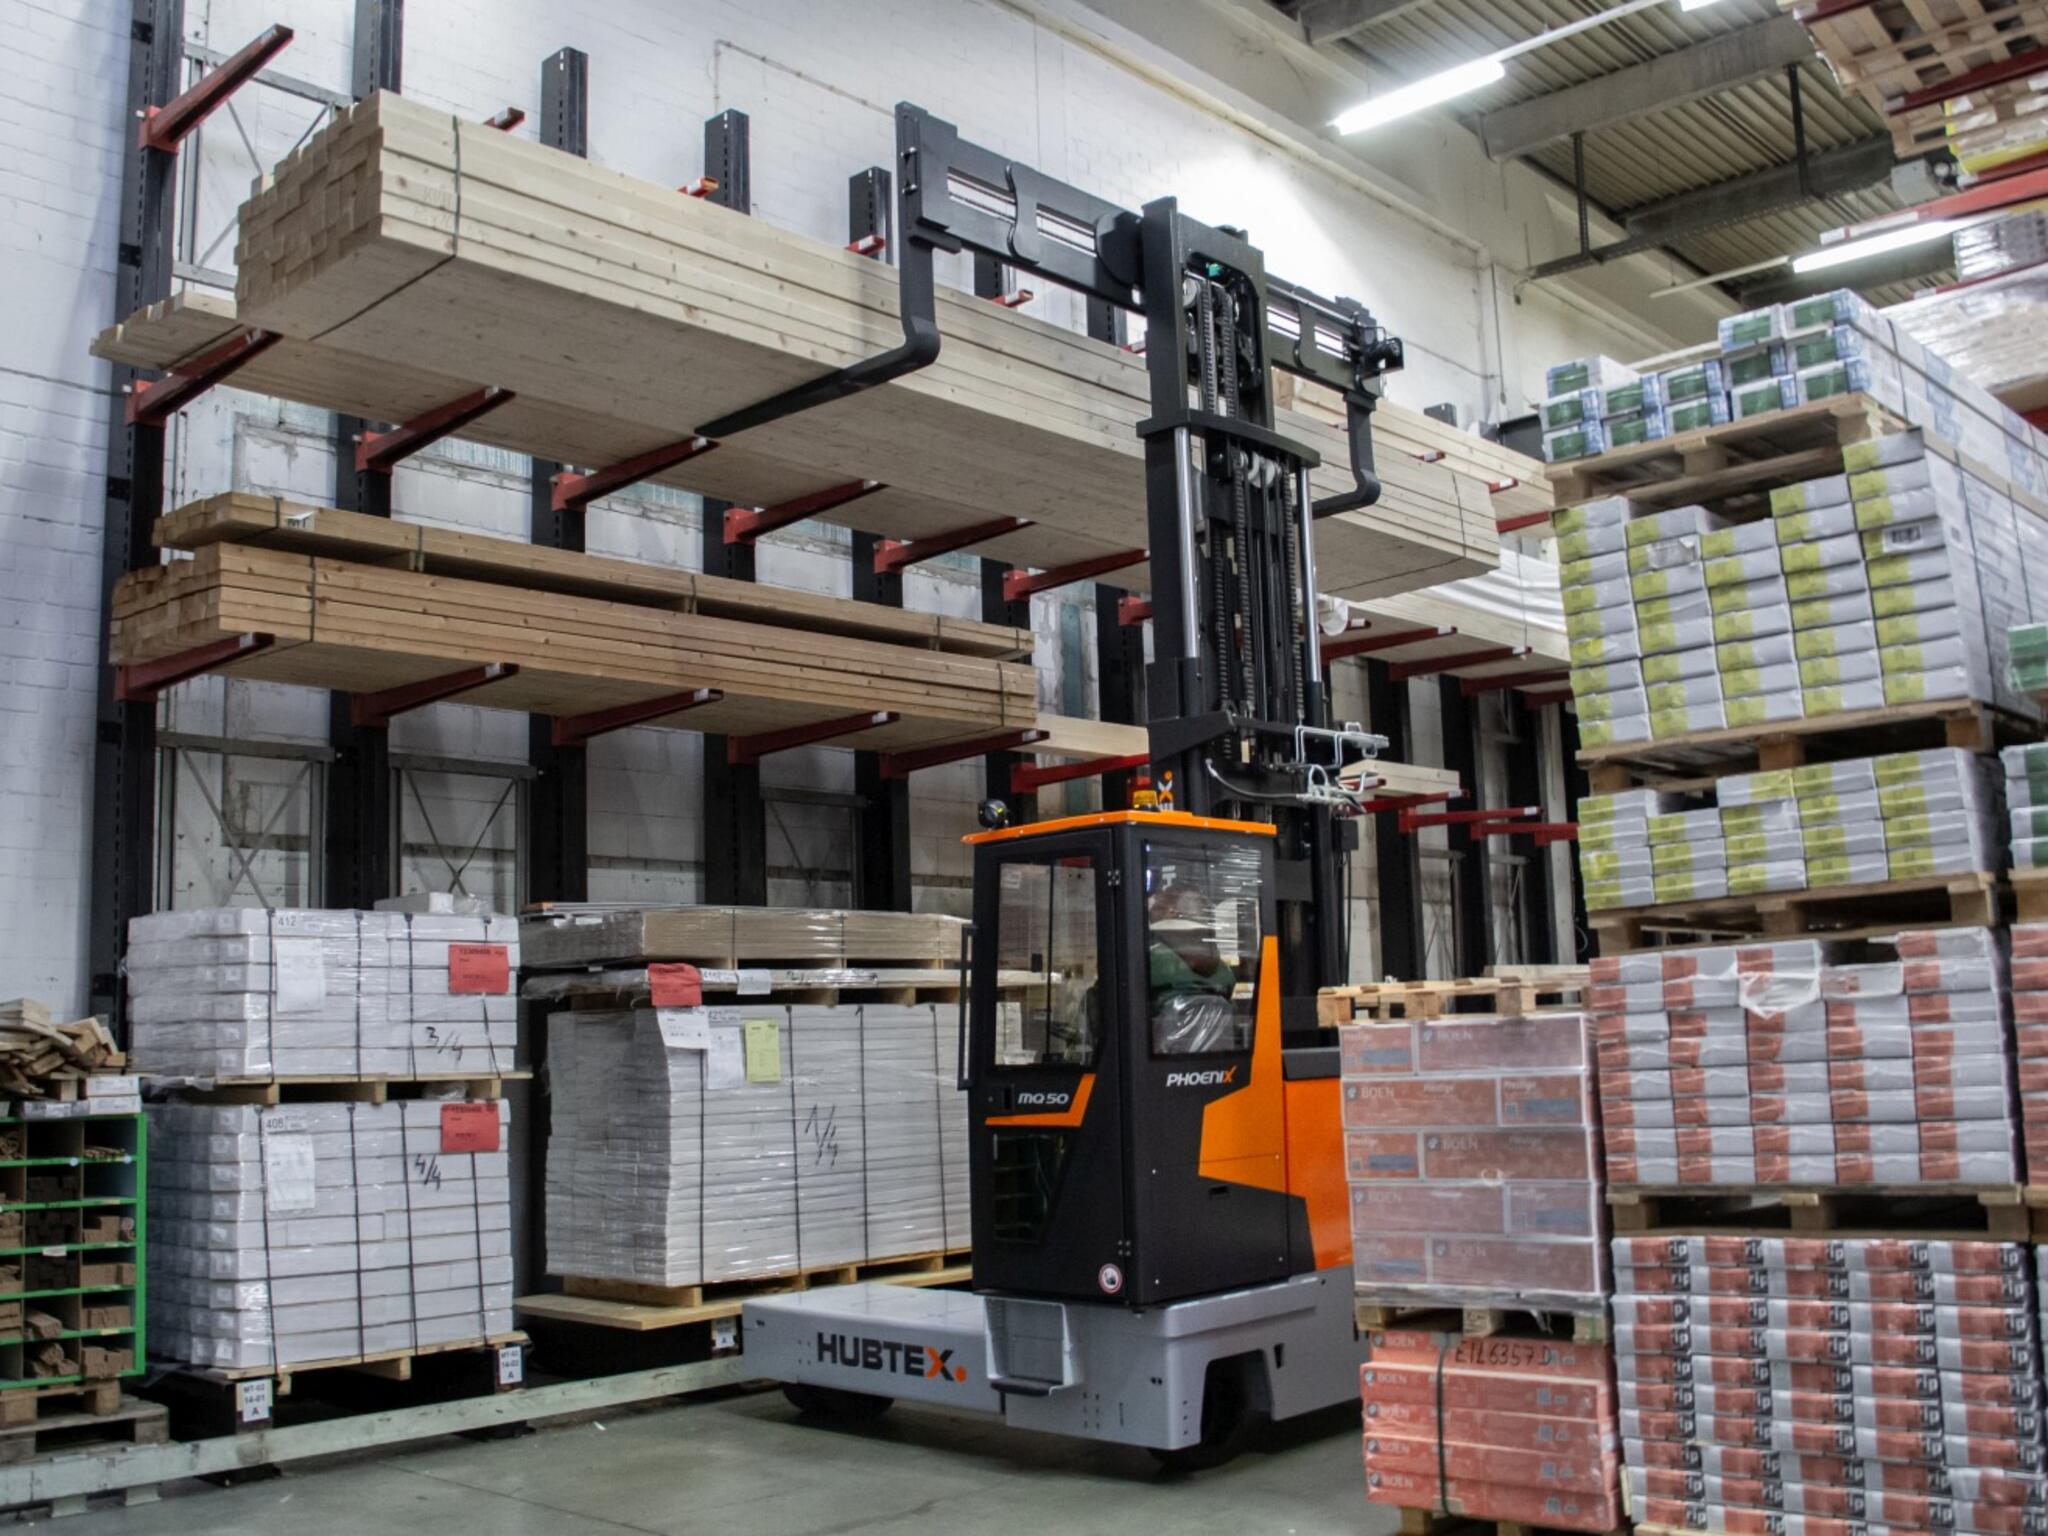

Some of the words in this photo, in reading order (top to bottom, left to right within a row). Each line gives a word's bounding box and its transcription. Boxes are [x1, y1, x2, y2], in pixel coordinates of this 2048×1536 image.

[425, 1026, 463, 1063] 3/4
[1166, 1065, 1238, 1087] PHOENIX
[1046, 1092, 1070, 1105] 50
[1360, 1086, 1395, 1099] BOEN
[804, 1104, 839, 1168] 1/4
[414, 1153, 442, 1191] 4/4
